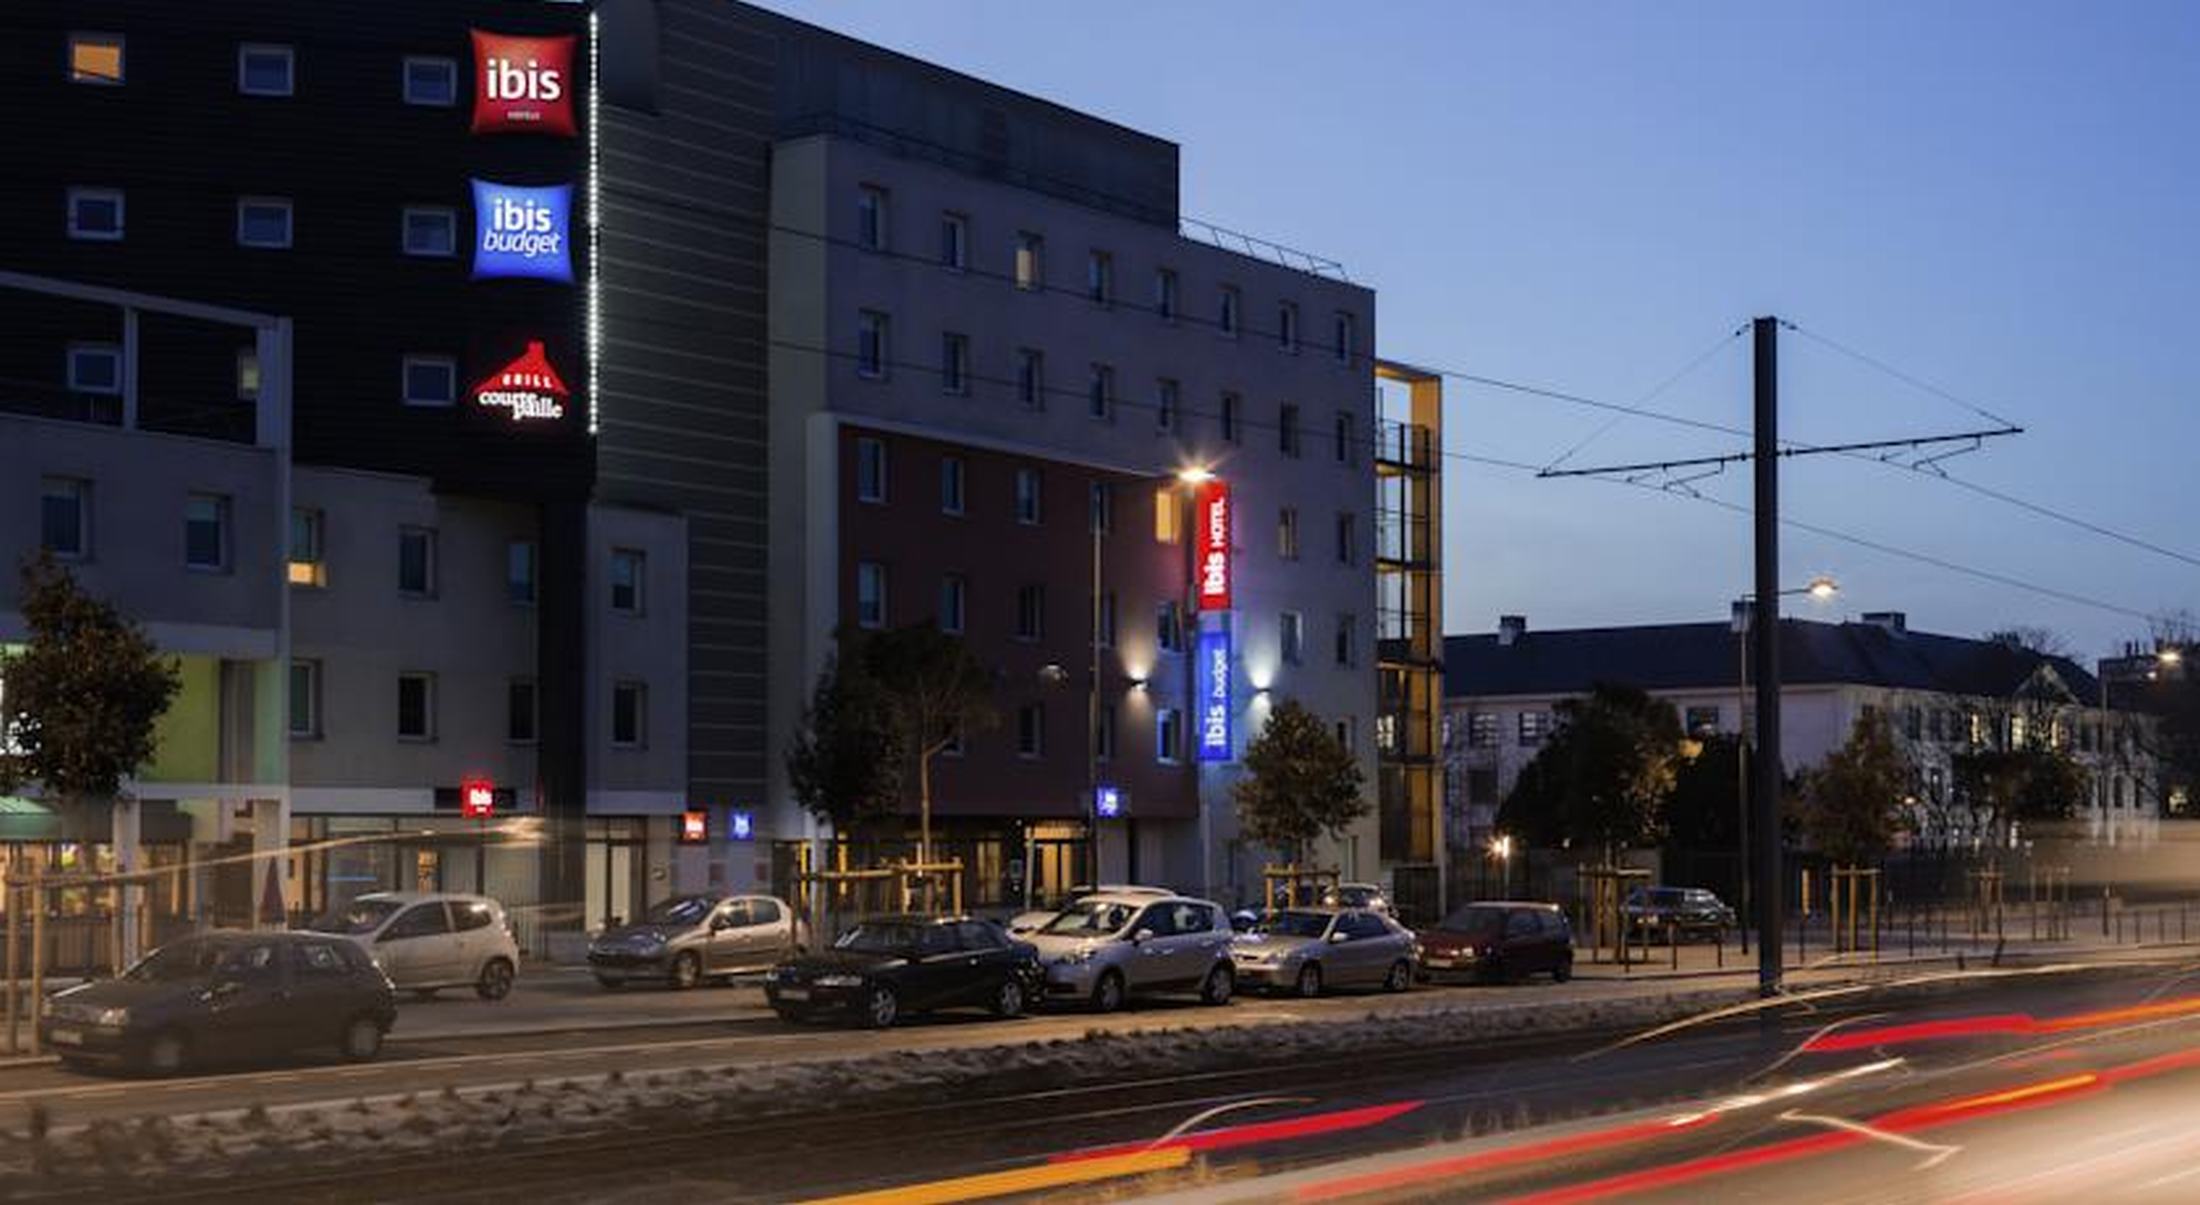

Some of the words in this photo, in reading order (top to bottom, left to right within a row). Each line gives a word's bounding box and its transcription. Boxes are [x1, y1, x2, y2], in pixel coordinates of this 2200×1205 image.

[487, 58, 561, 101] ibis
[494, 198, 552, 232] ibis
[483, 229, 561, 257] budget
[1203, 552, 1225, 595] ibis
[1204, 705, 1226, 746] ibis
